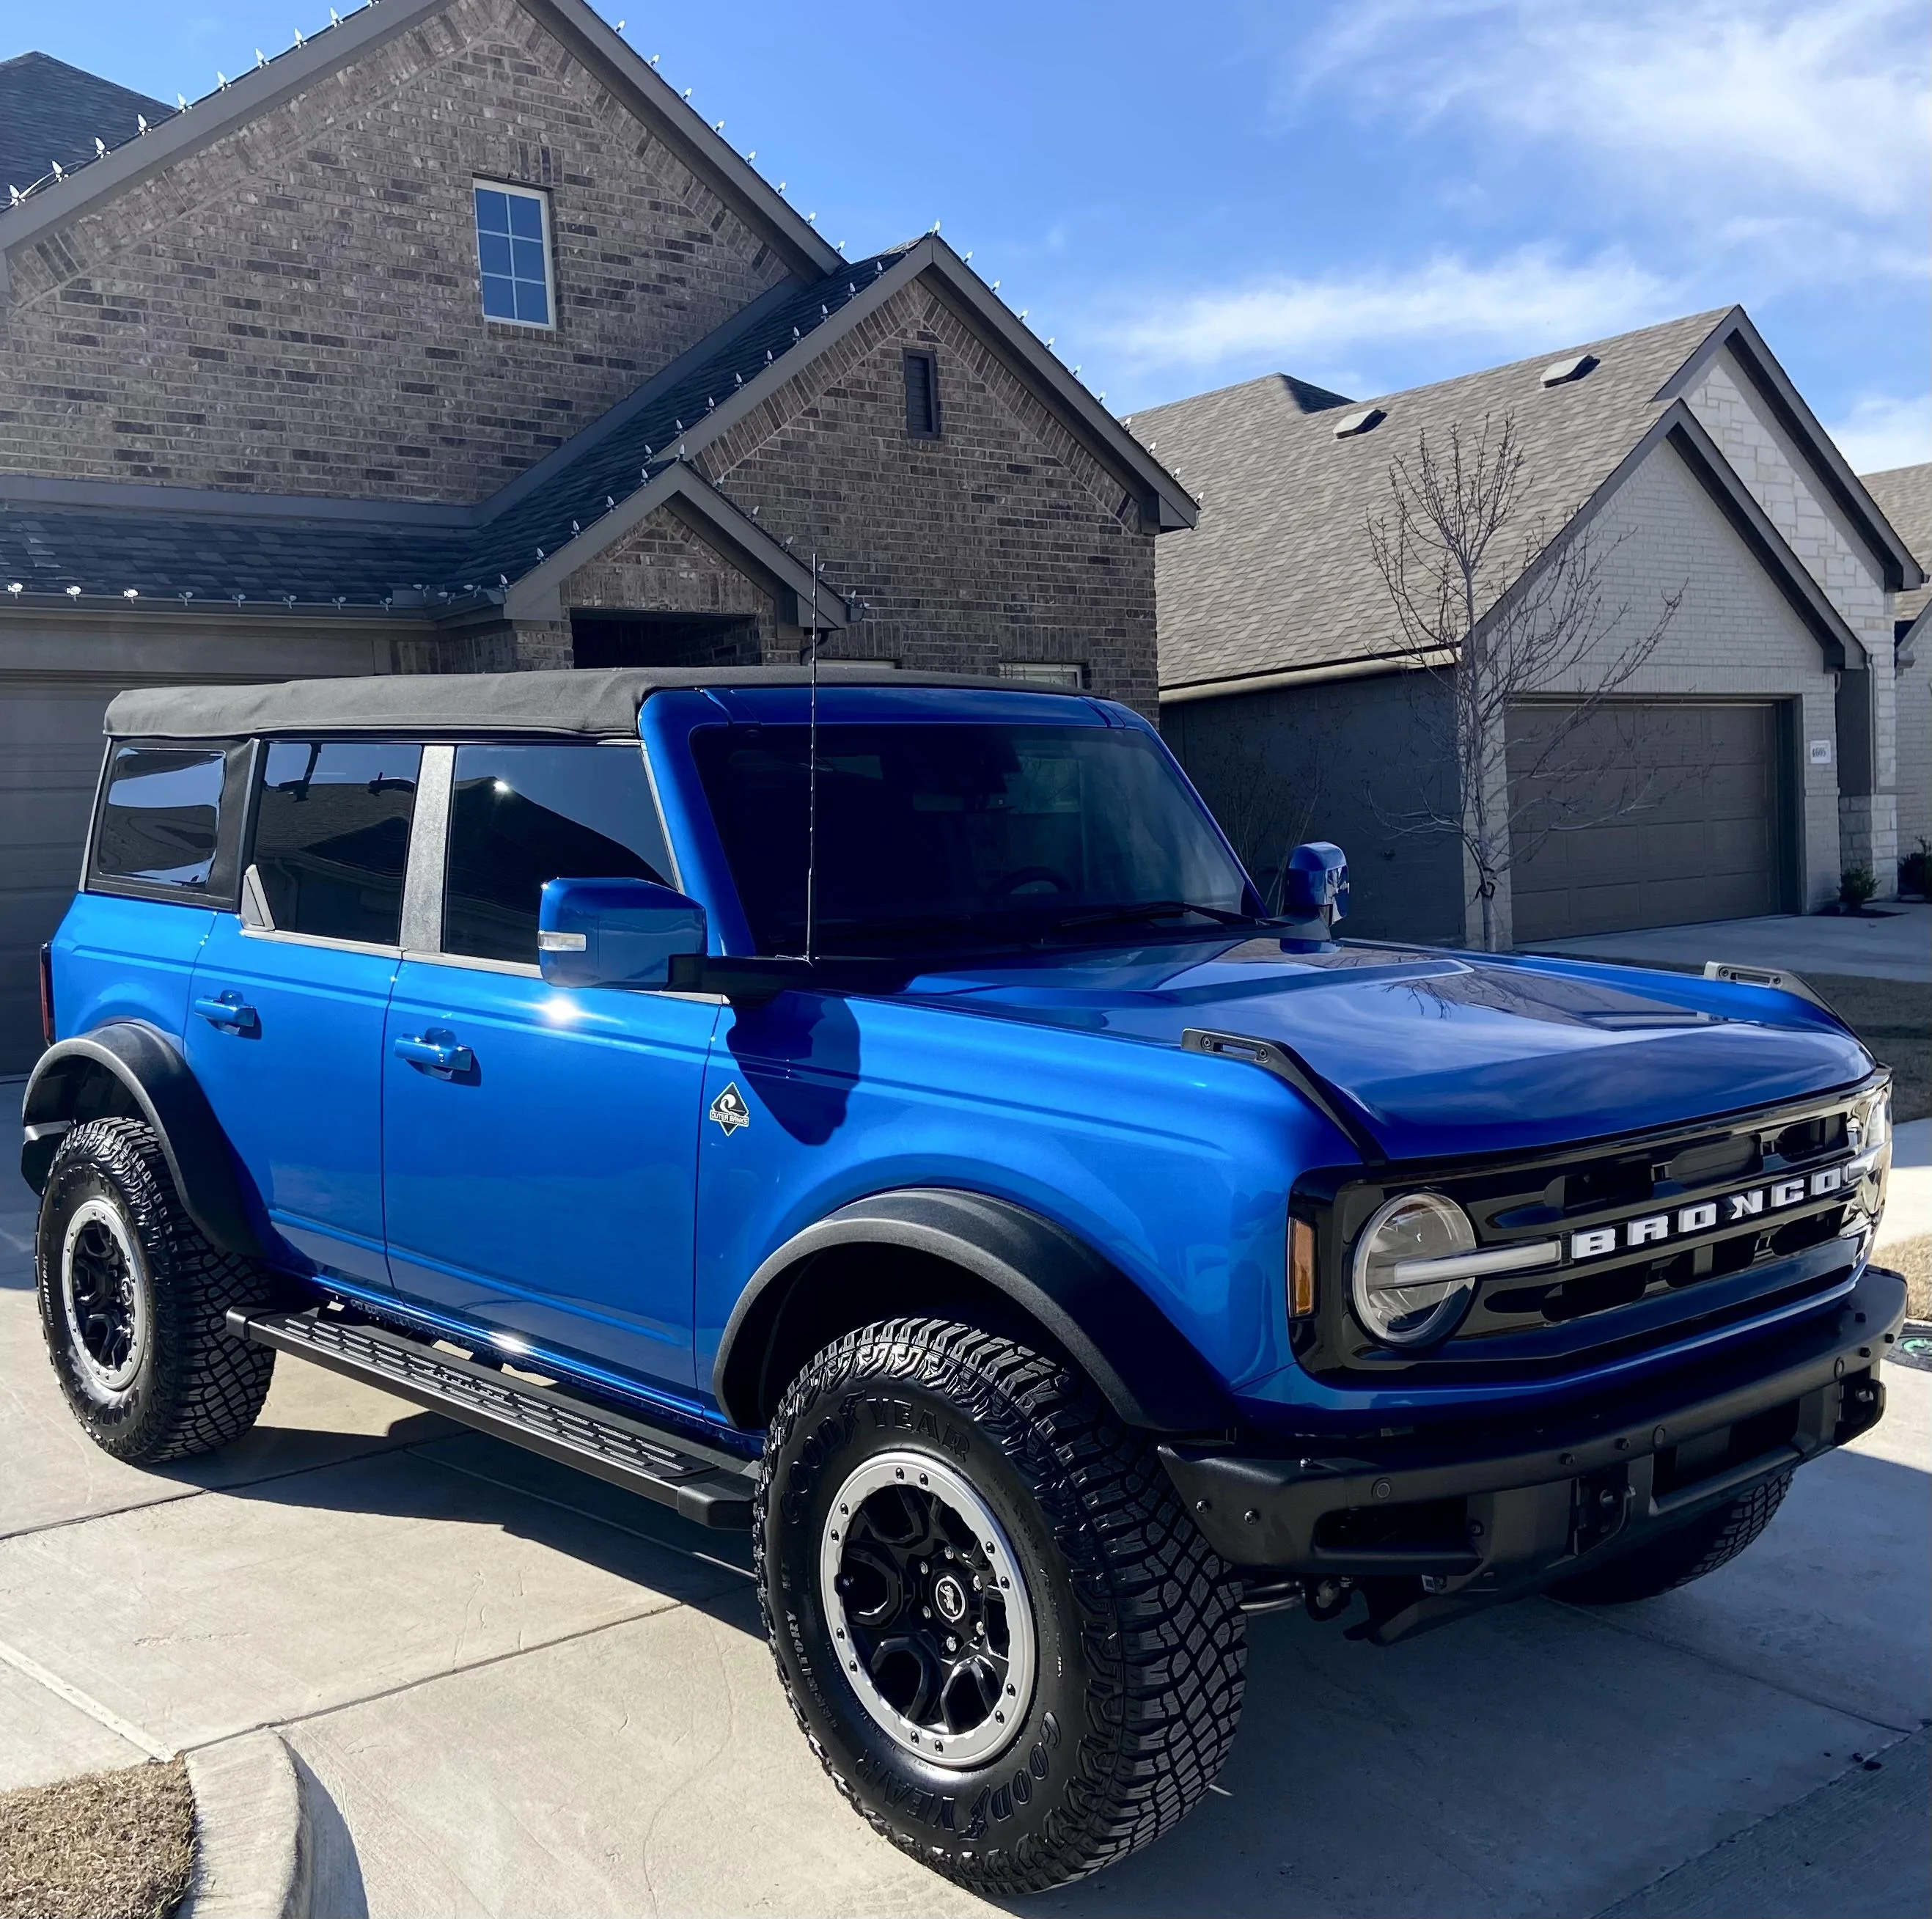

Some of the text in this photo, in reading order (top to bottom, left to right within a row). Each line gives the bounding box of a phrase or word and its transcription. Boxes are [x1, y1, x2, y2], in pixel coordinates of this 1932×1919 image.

[711, 1112, 748, 1124] OUTER BANKS
[1571, 1167, 1842, 1259] BRONCO
